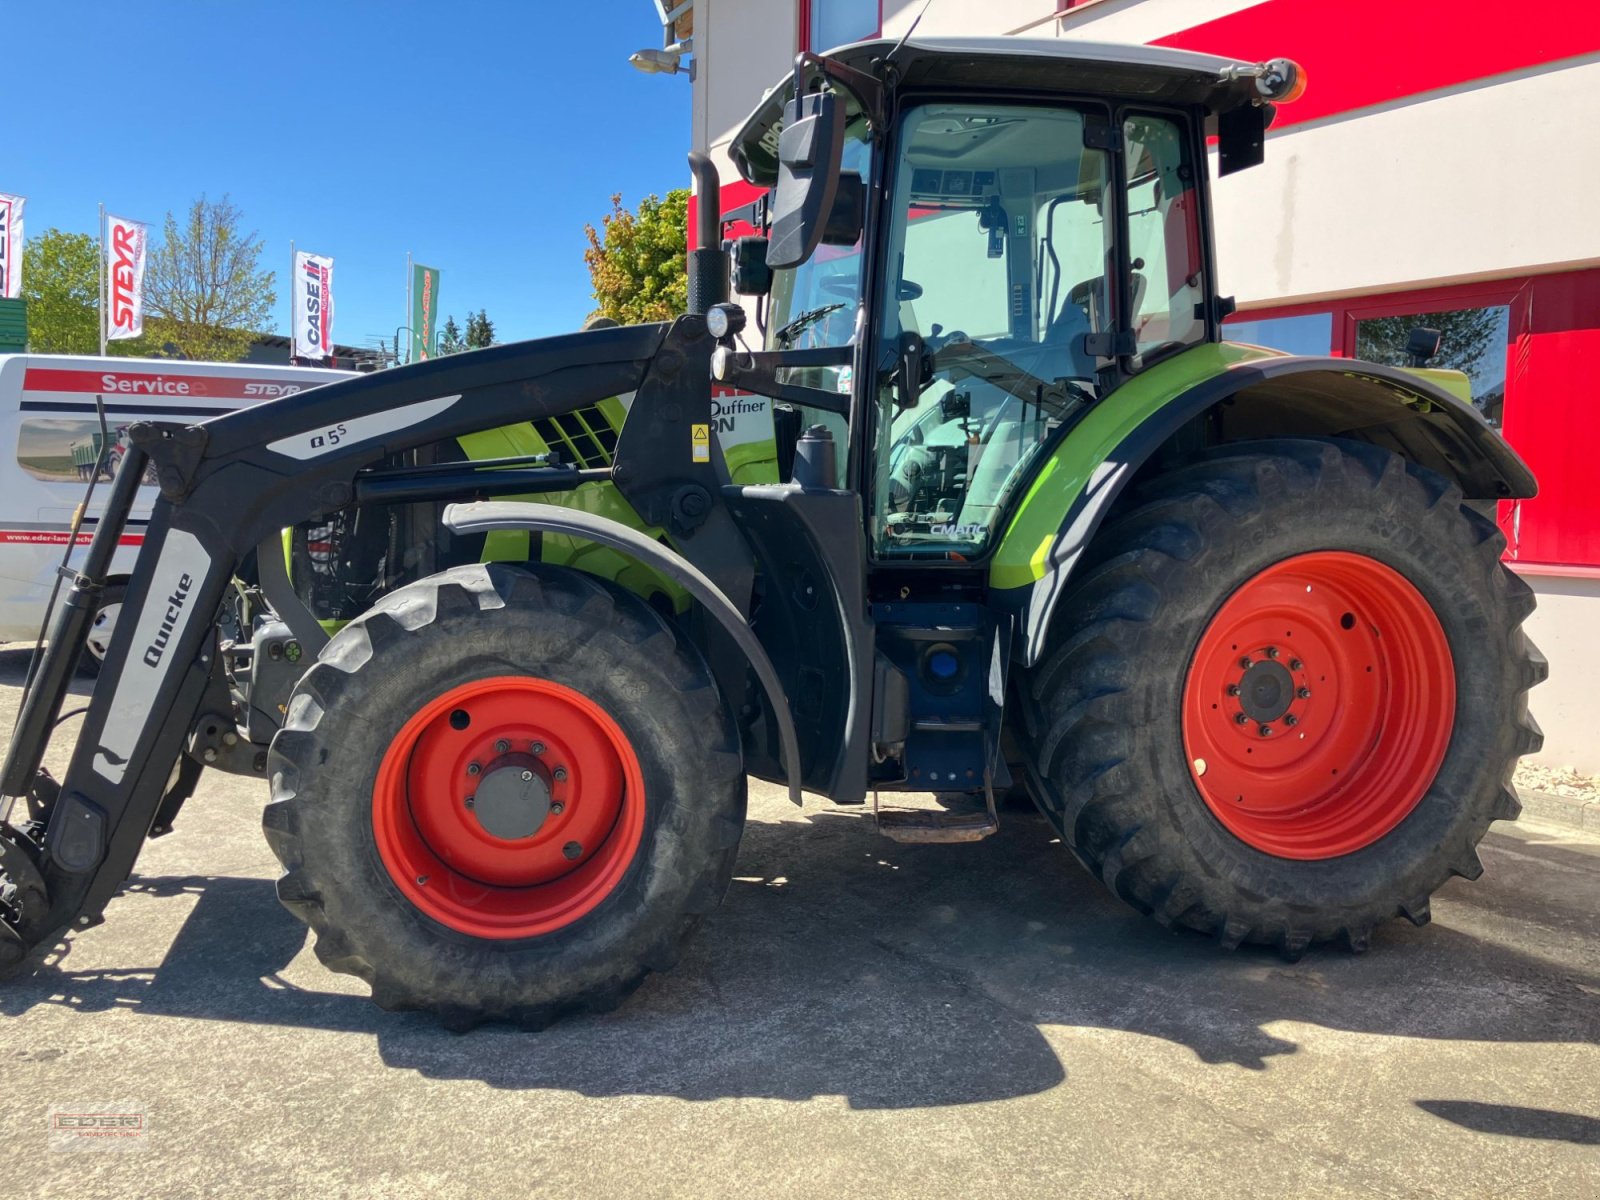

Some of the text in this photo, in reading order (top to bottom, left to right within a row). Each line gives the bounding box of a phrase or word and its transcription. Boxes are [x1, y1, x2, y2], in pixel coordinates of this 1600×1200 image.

[113, 224, 135, 332] STEYR
[307, 282, 320, 345] CASE
[101, 375, 190, 394] Service
[243, 383, 300, 395] STEYR
[930, 524, 988, 535] CMATIC
[143, 573, 193, 669] Quicke
